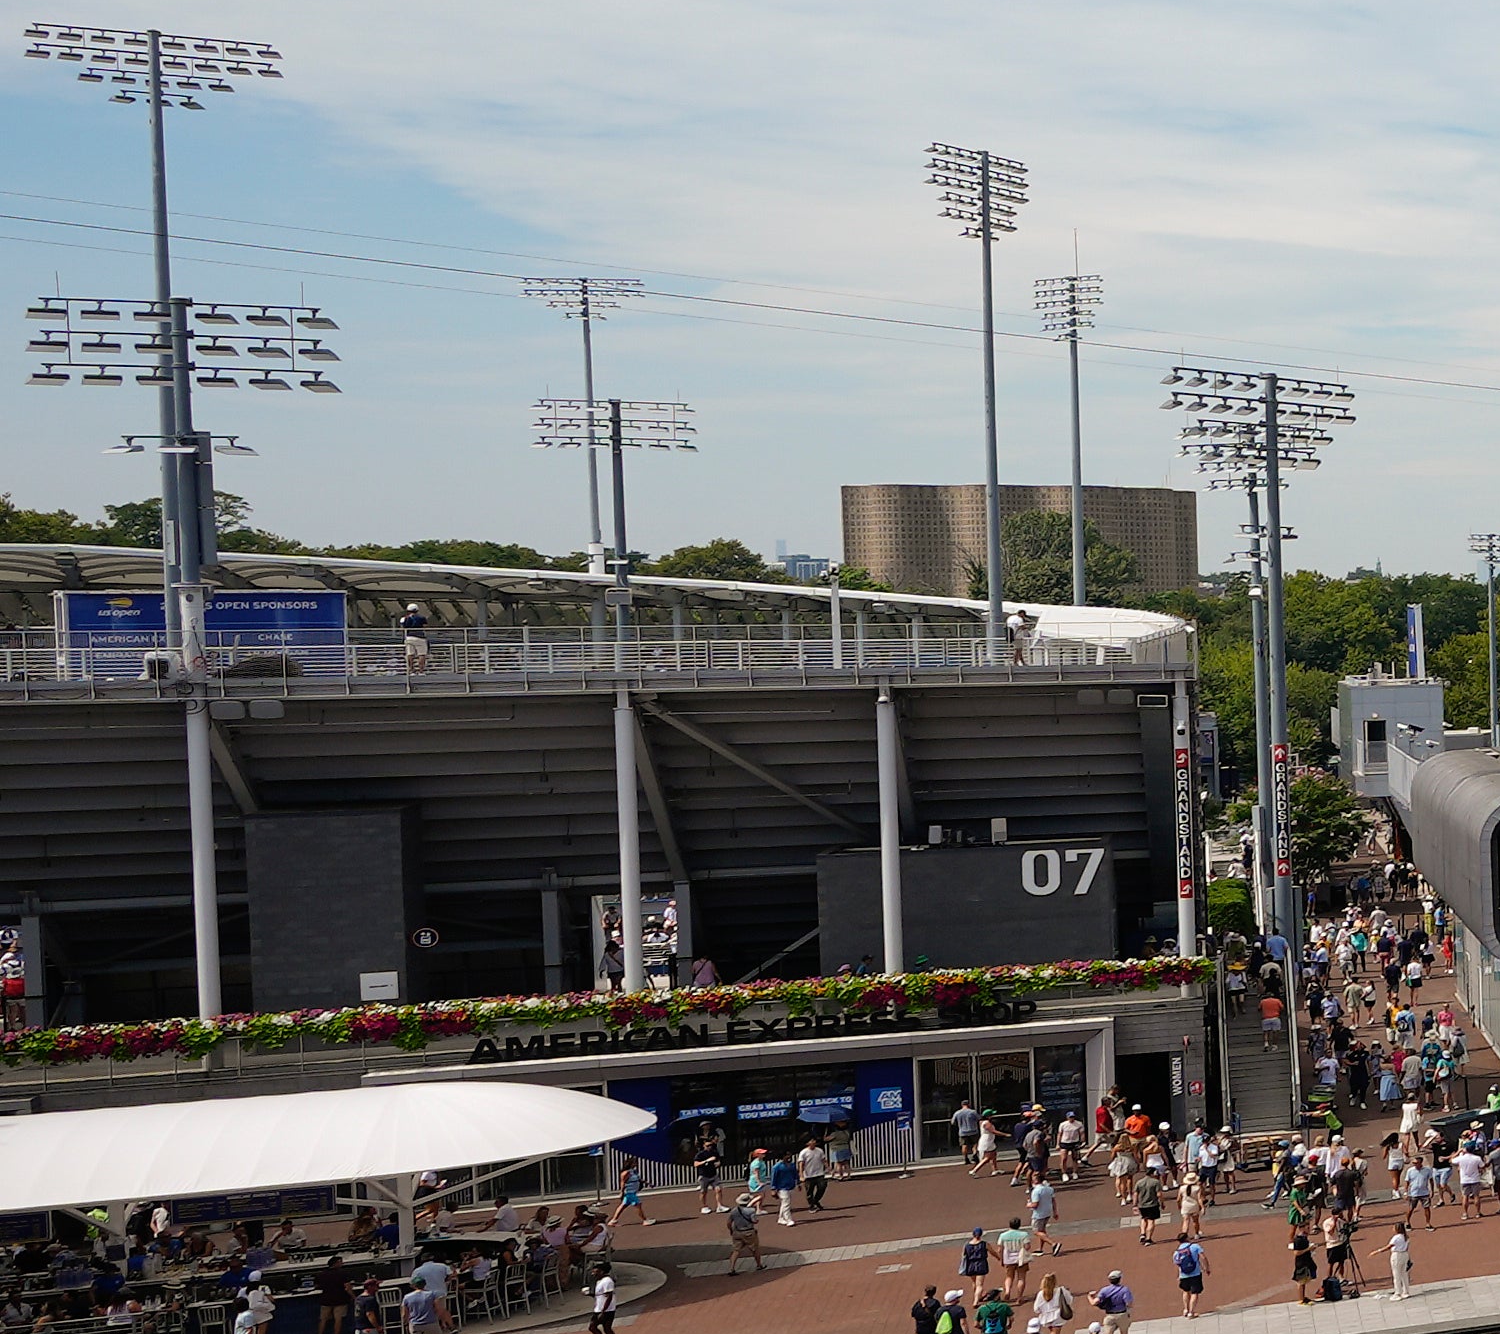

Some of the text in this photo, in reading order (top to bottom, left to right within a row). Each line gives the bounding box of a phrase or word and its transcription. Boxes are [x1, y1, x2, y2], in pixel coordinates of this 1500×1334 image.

[215, 600, 318, 611] OPEN SPONSORS
[1177, 768, 1193, 880] GRANDSTAND
[1275, 762, 1290, 860] GRANDSTAND
[1021, 848, 1105, 896] 07
[467, 1023, 709, 1064] AMERICAN
[877, 1089, 902, 1103] AM
[1172, 1055, 1183, 1097] WOMEN
[881, 1099, 903, 1110] EX
